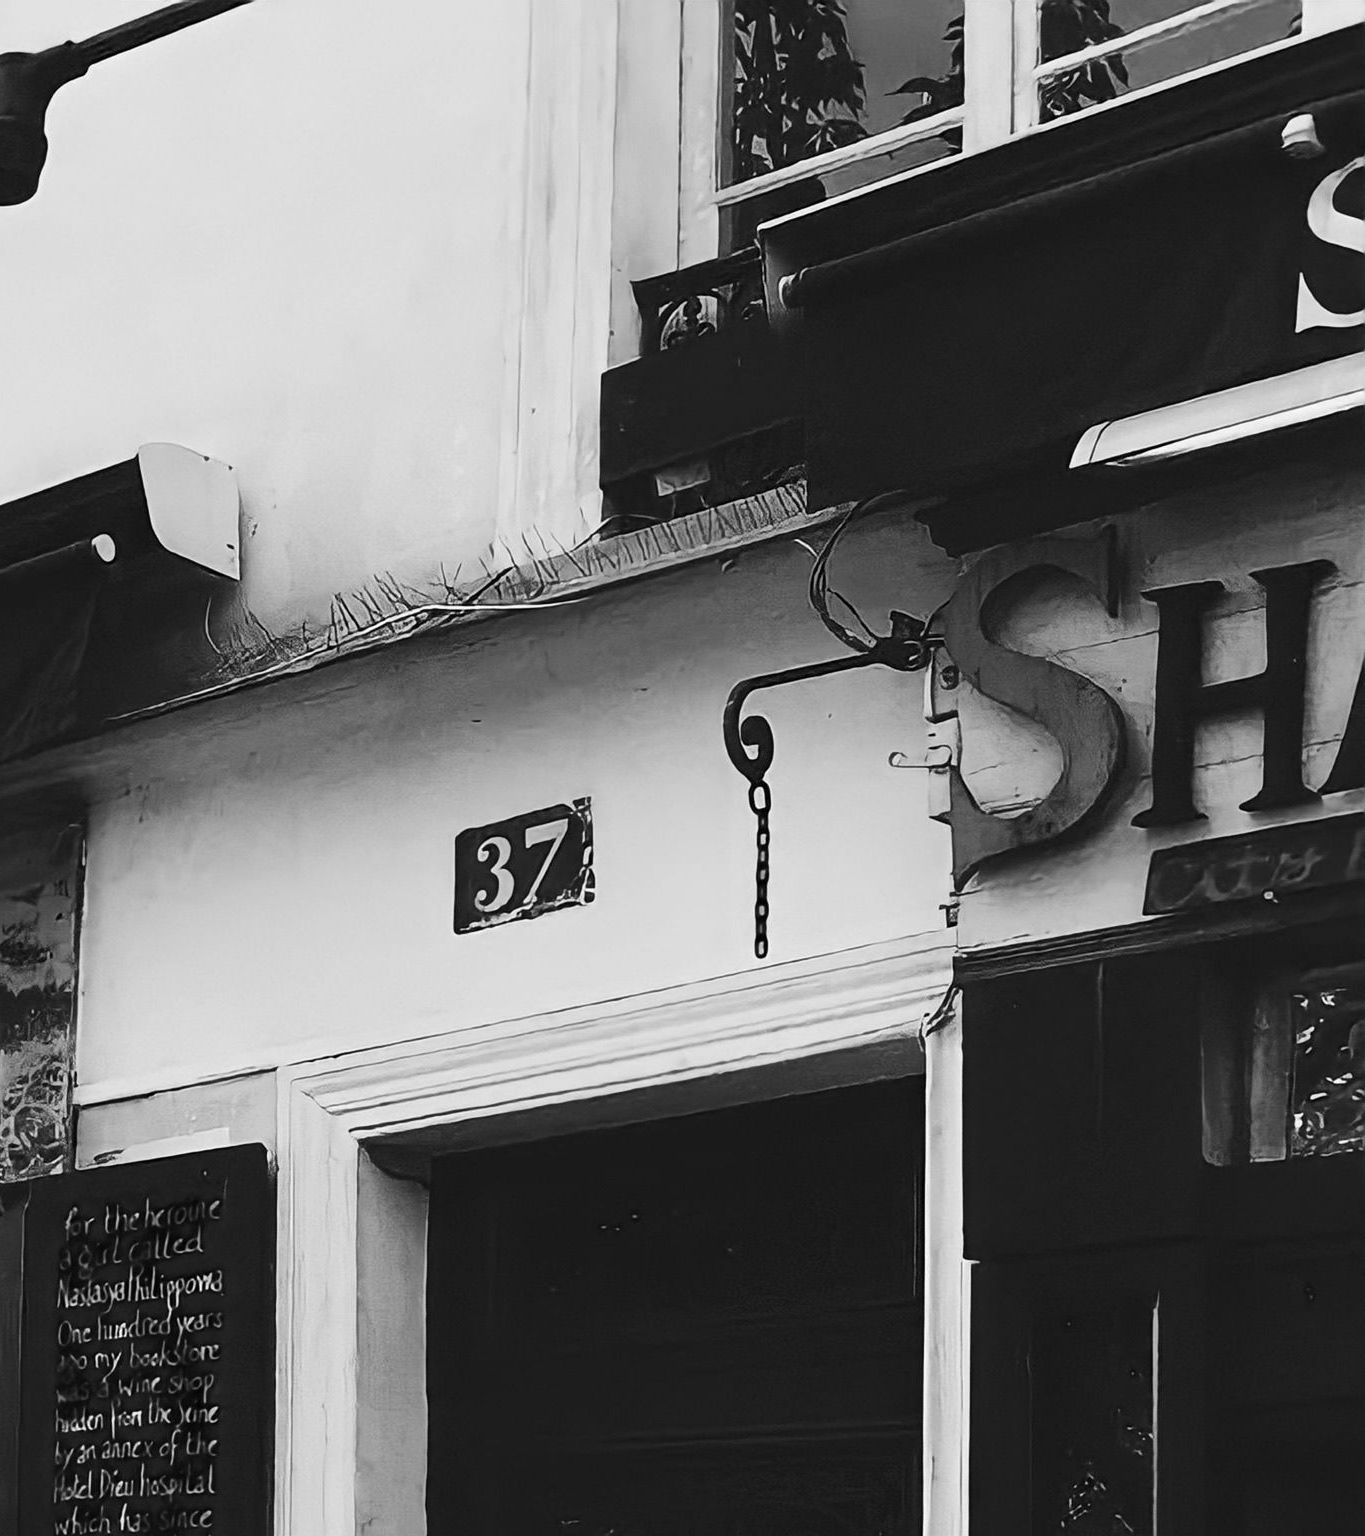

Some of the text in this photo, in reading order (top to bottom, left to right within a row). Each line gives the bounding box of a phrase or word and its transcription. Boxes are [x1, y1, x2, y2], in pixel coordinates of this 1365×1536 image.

[474, 818, 569, 913] 37
[104, 1204, 139, 1234] the
[129, 1225, 204, 1261] called
[58, 1320, 92, 1347] One
[177, 1312, 222, 1349] years
[95, 1352, 121, 1383] my
[119, 1376, 162, 1397] wine
[148, 1399, 171, 1424] the
[55, 1429, 218, 1472] by an annex of the
[99, 1469, 134, 1498] Dieu
[140, 1462, 215, 1502] hospital
[54, 1503, 213, 1535] which has since
